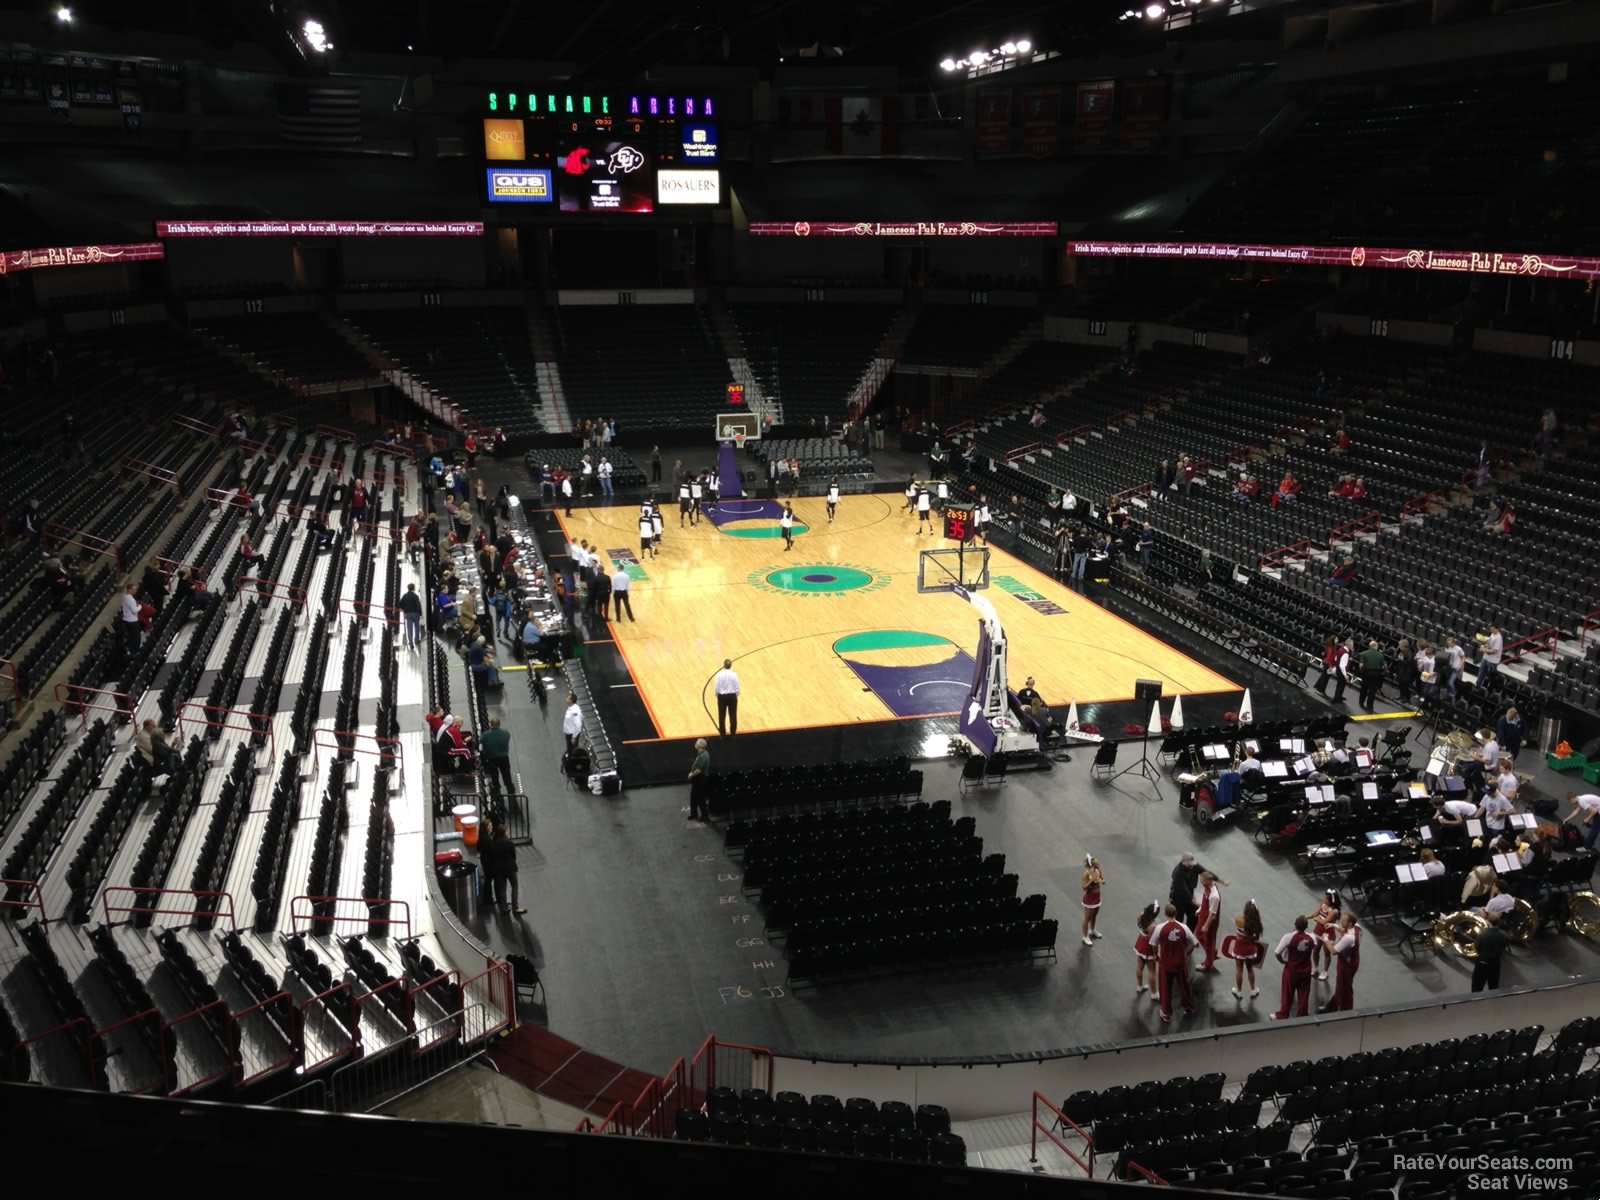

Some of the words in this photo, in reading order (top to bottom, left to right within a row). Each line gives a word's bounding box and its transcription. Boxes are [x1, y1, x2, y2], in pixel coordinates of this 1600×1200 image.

[489, 93, 609, 113] SPOKANE
[631, 97, 712, 114] ARENA
[682, 143, 717, 151] Washington
[661, 180, 716, 192] ROSAUERS
[167, 224, 186, 232] Irish
[187, 224, 212, 233] brews,
[213, 224, 236, 234] spirits
[237, 224, 251, 232] and
[252, 224, 289, 232] traditional
[292, 224, 307, 234] pub
[308, 224, 324, 232] fare
[326, 224, 337, 232] all
[338, 225, 354, 234] year
[356, 224, 376, 233] long!
[425, 224, 447, 232] behind
[875, 222, 916, 235] Jameson
[918, 222, 936, 235] Pub
[938, 222, 958, 235] Fare
[48, 248, 66, 265] Pub
[66, 248, 86, 264] Fare
[1074, 244, 1090, 252] Irish
[1090, 244, 1110, 254] brews,
[1111, 245, 1132, 254] spirits
[1132, 244, 1145, 253] and
[1146, 245, 1182, 254] traditional
[1184, 246, 1197, 256] pub
[1198, 246, 1209, 254] fare
[1216, 248, 1226, 256] year
[1272, 249, 1287, 258] behind
[1426, 251, 1468, 271] Jameson
[1470, 252, 1491, 272] Pub
[1492, 253, 1518, 273] Fare
[424, 292, 441, 305] 111
[246, 299, 263, 312] 112
[112, 309, 125, 325] 113
[1090, 321, 1106, 335] 107
[1371, 320, 1388, 336] 105
[1551, 339, 1574, 360] 104
[947, 509, 968, 520] 26:53
[950, 520, 964, 539] 35
[720, 896, 738, 904] EE
[752, 960, 776, 970] HH
